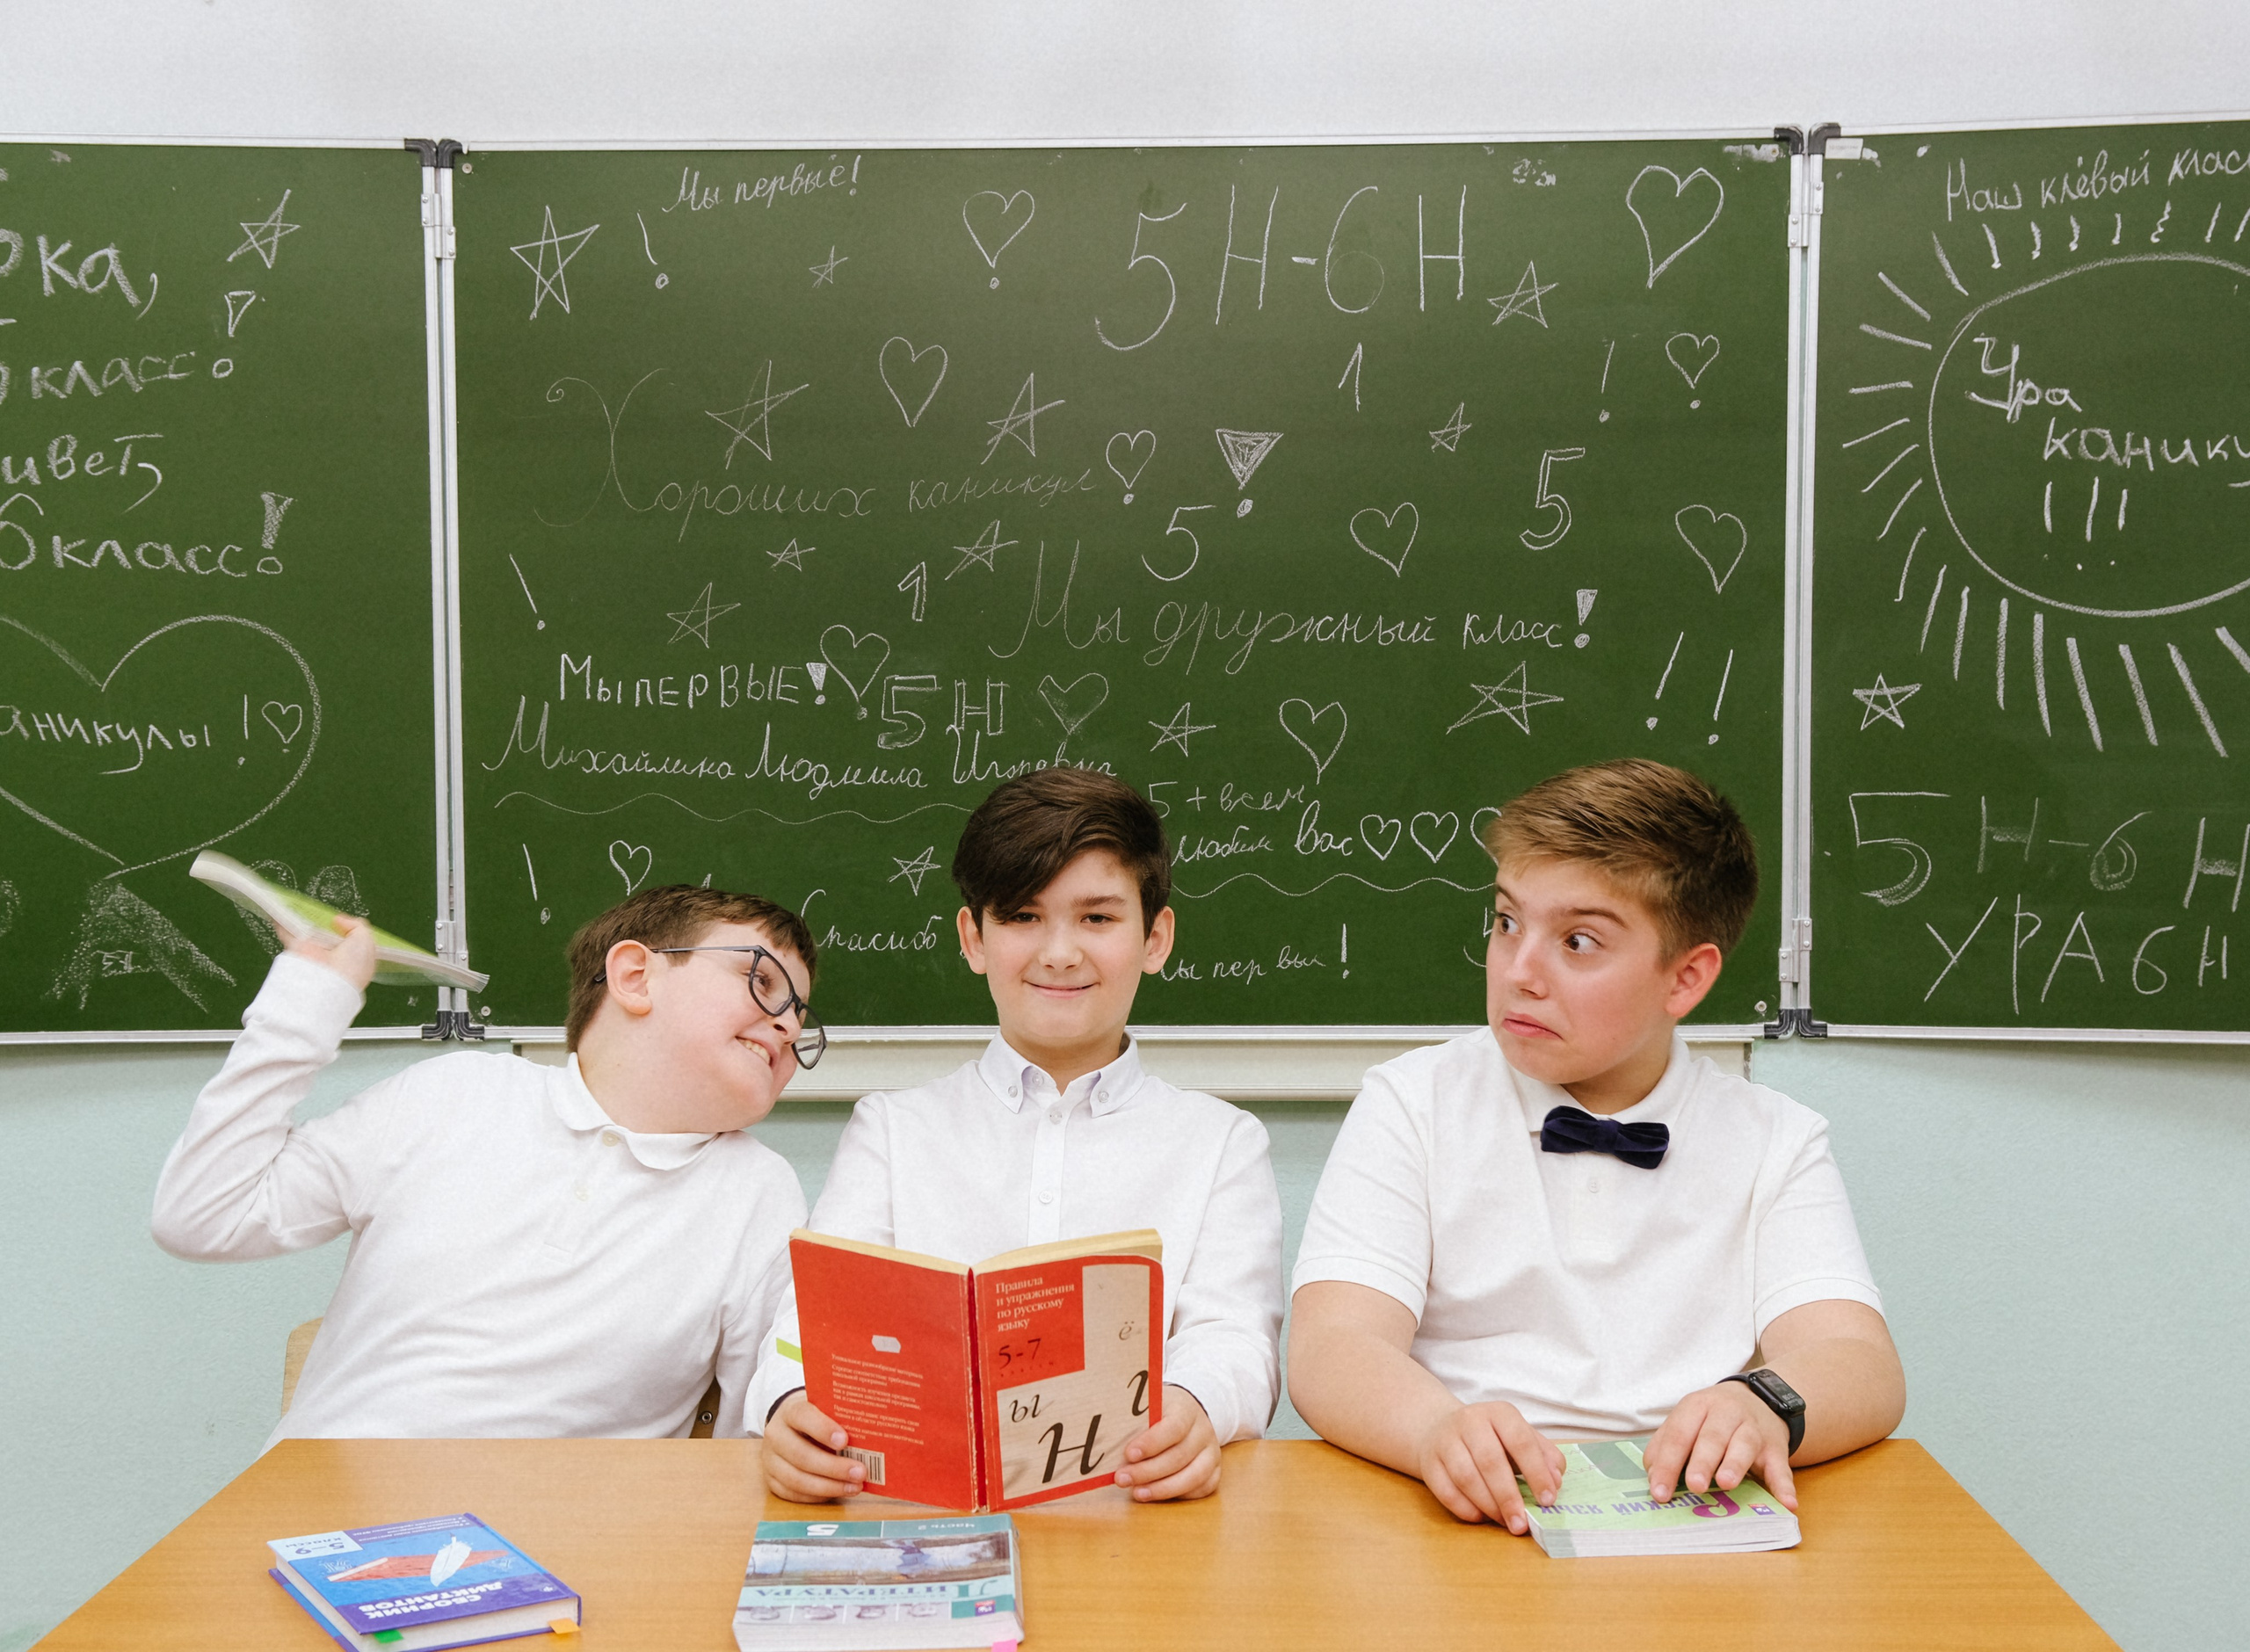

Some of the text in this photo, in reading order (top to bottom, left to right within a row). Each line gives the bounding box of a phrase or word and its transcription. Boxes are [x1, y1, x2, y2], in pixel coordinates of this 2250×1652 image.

[1947, 158, 2022, 221] Наш
[2167, 149, 2250, 185] клас
[1964, 332, 2082, 424] Ура
[996, 1277, 1043, 1294] Правила
[996, 1284, 1075, 1307] и упражнения
[997, 1298, 1064, 1320] по русскому
[998, 1318, 1030, 1332] языку
[359, 1582, 503, 1612] ДИКТАНТОВ
[364, 1594, 482, 1619] СБОРНИК
